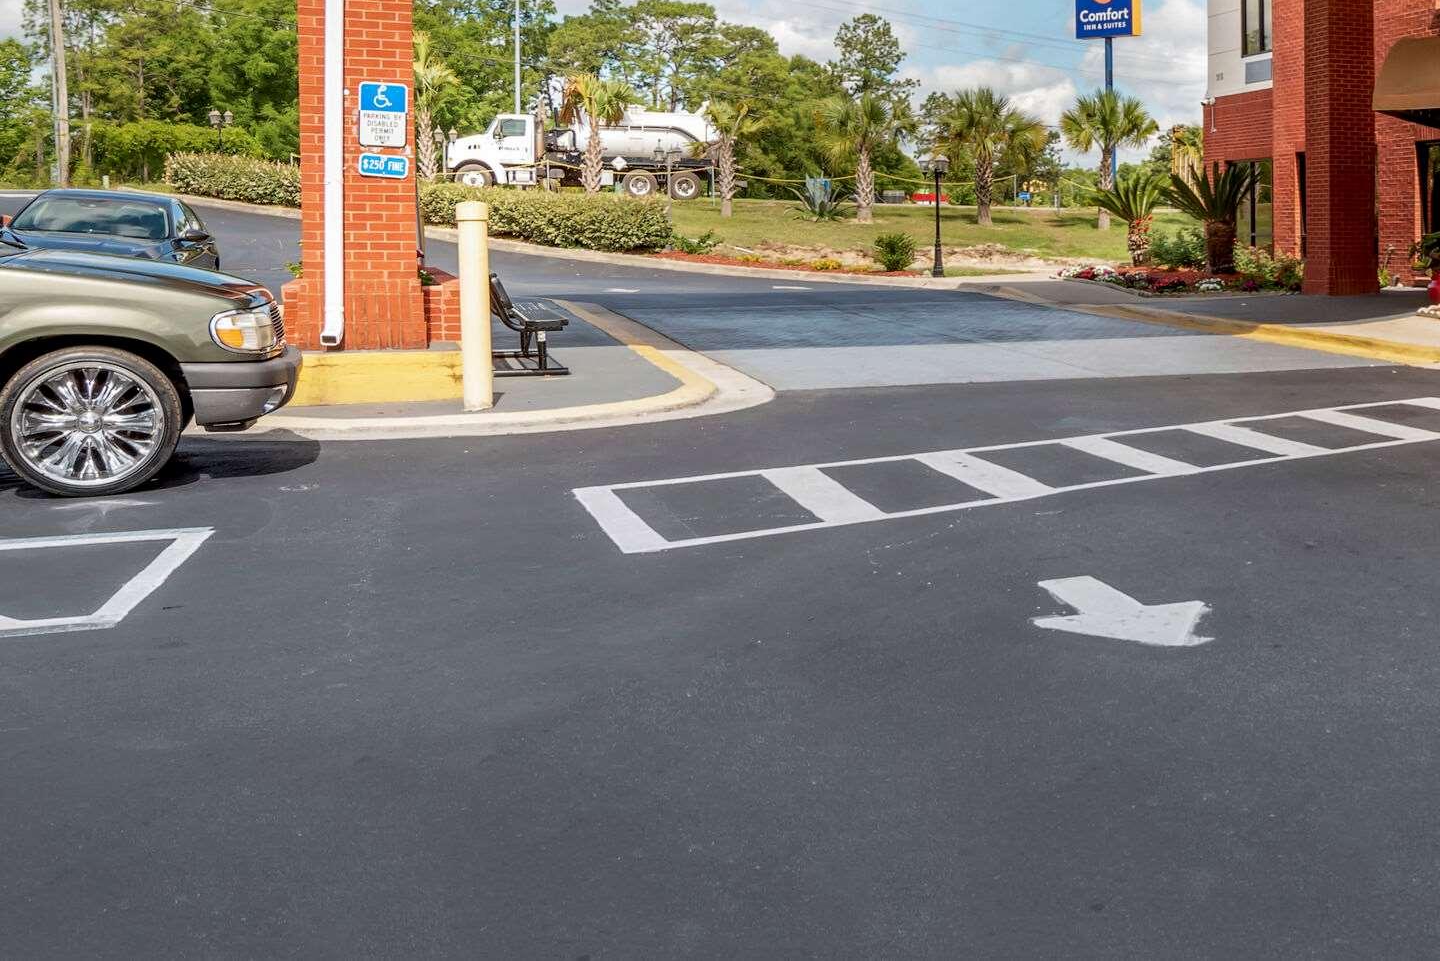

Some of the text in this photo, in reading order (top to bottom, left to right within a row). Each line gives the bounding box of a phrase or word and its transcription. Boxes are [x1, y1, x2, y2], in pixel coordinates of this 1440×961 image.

[1080, 7, 1129, 23] Comfort
[1103, 22, 1126, 30] SUITES
[367, 120, 399, 128] DISABLED
[370, 127, 394, 135] PERMIT
[362, 158, 405, 172] $250 FINE
